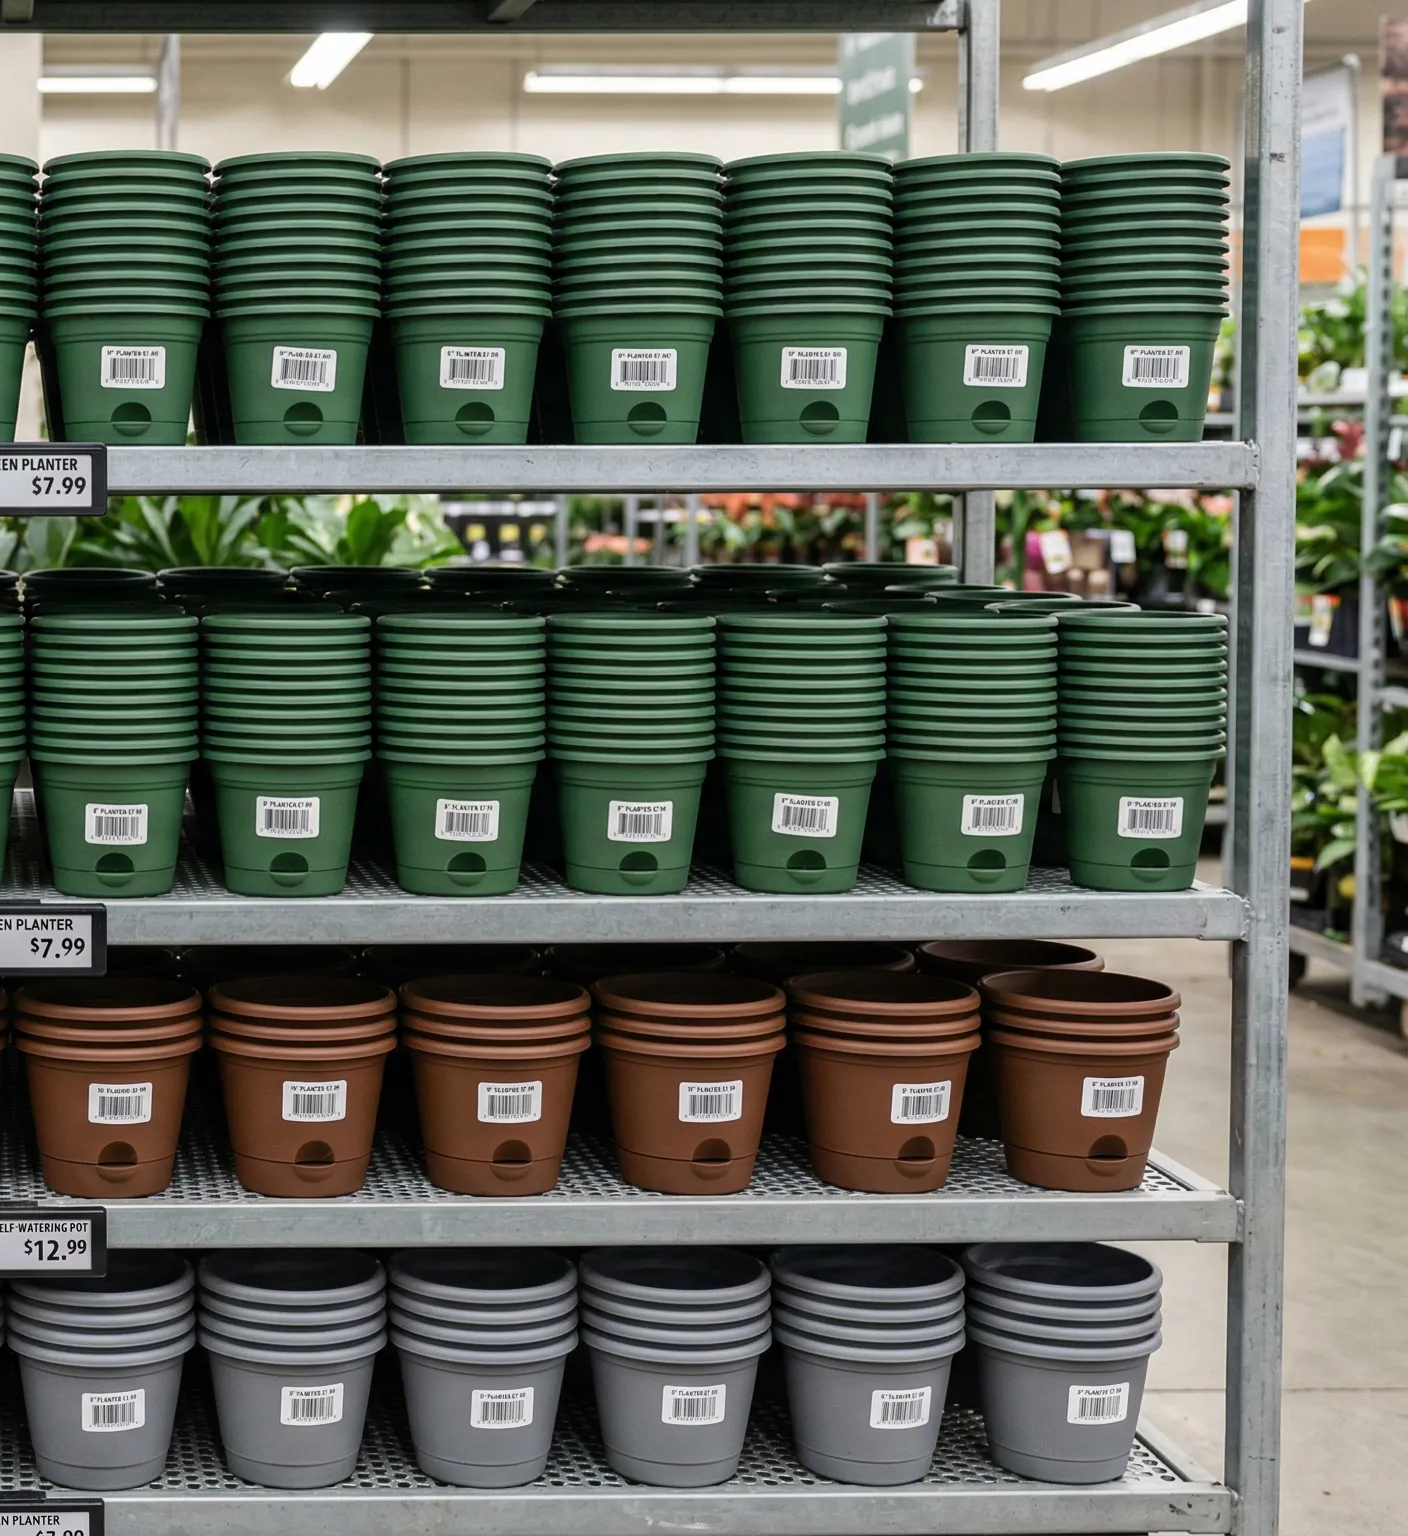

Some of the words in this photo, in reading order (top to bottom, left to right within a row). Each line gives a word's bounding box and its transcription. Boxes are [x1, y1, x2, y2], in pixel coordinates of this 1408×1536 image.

[22, 458, 78, 471] PLANTER
[32, 476, 86, 495] $7.99
[16, 919, 73, 931] PLANTER
[30, 937, 85, 959] $7.99
[70, 1222, 88, 1233] POT
[24, 1239, 87, 1261] $12.99
[13, 1515, 60, 1525] PLANTER
